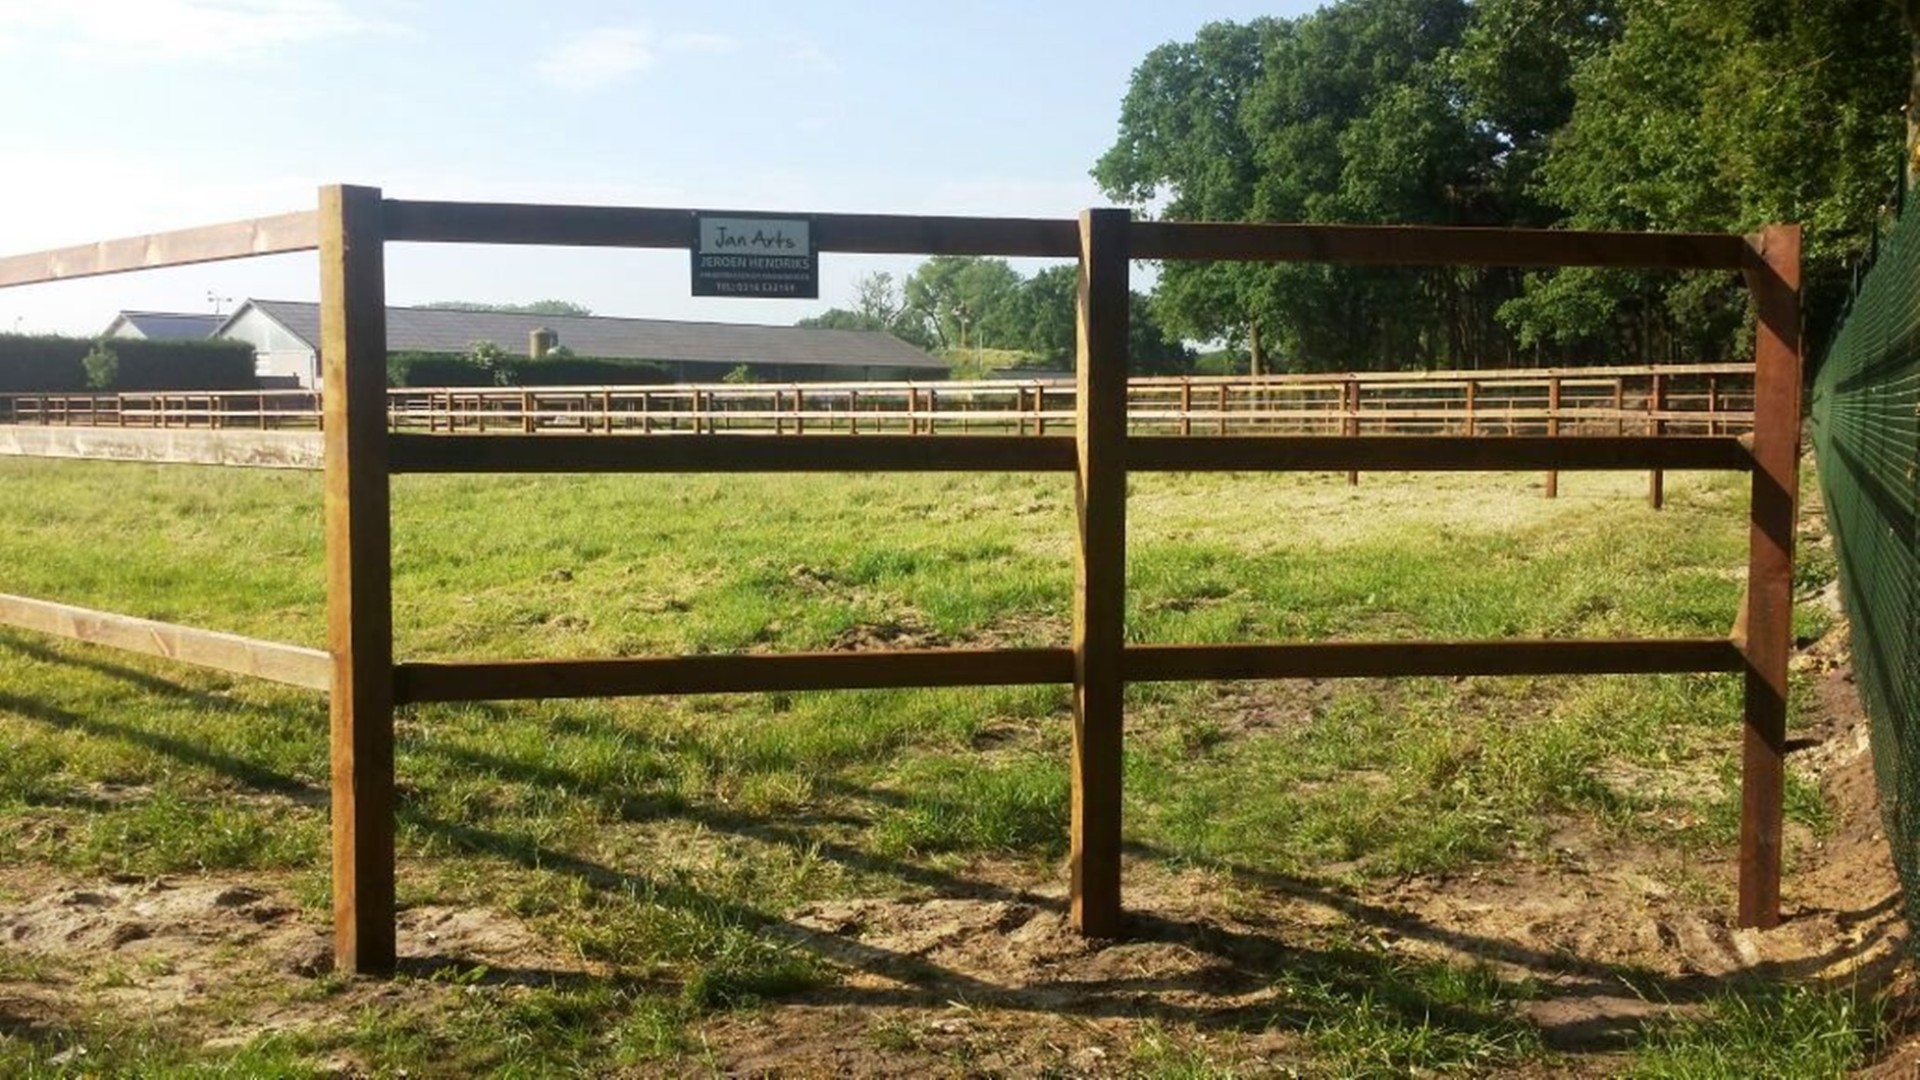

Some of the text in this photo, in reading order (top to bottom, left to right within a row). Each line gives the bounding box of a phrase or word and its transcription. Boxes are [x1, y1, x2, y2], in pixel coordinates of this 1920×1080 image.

[715, 226, 796, 249] Jan Arts
[701, 256, 810, 269] JEROEN HENDRIKS
